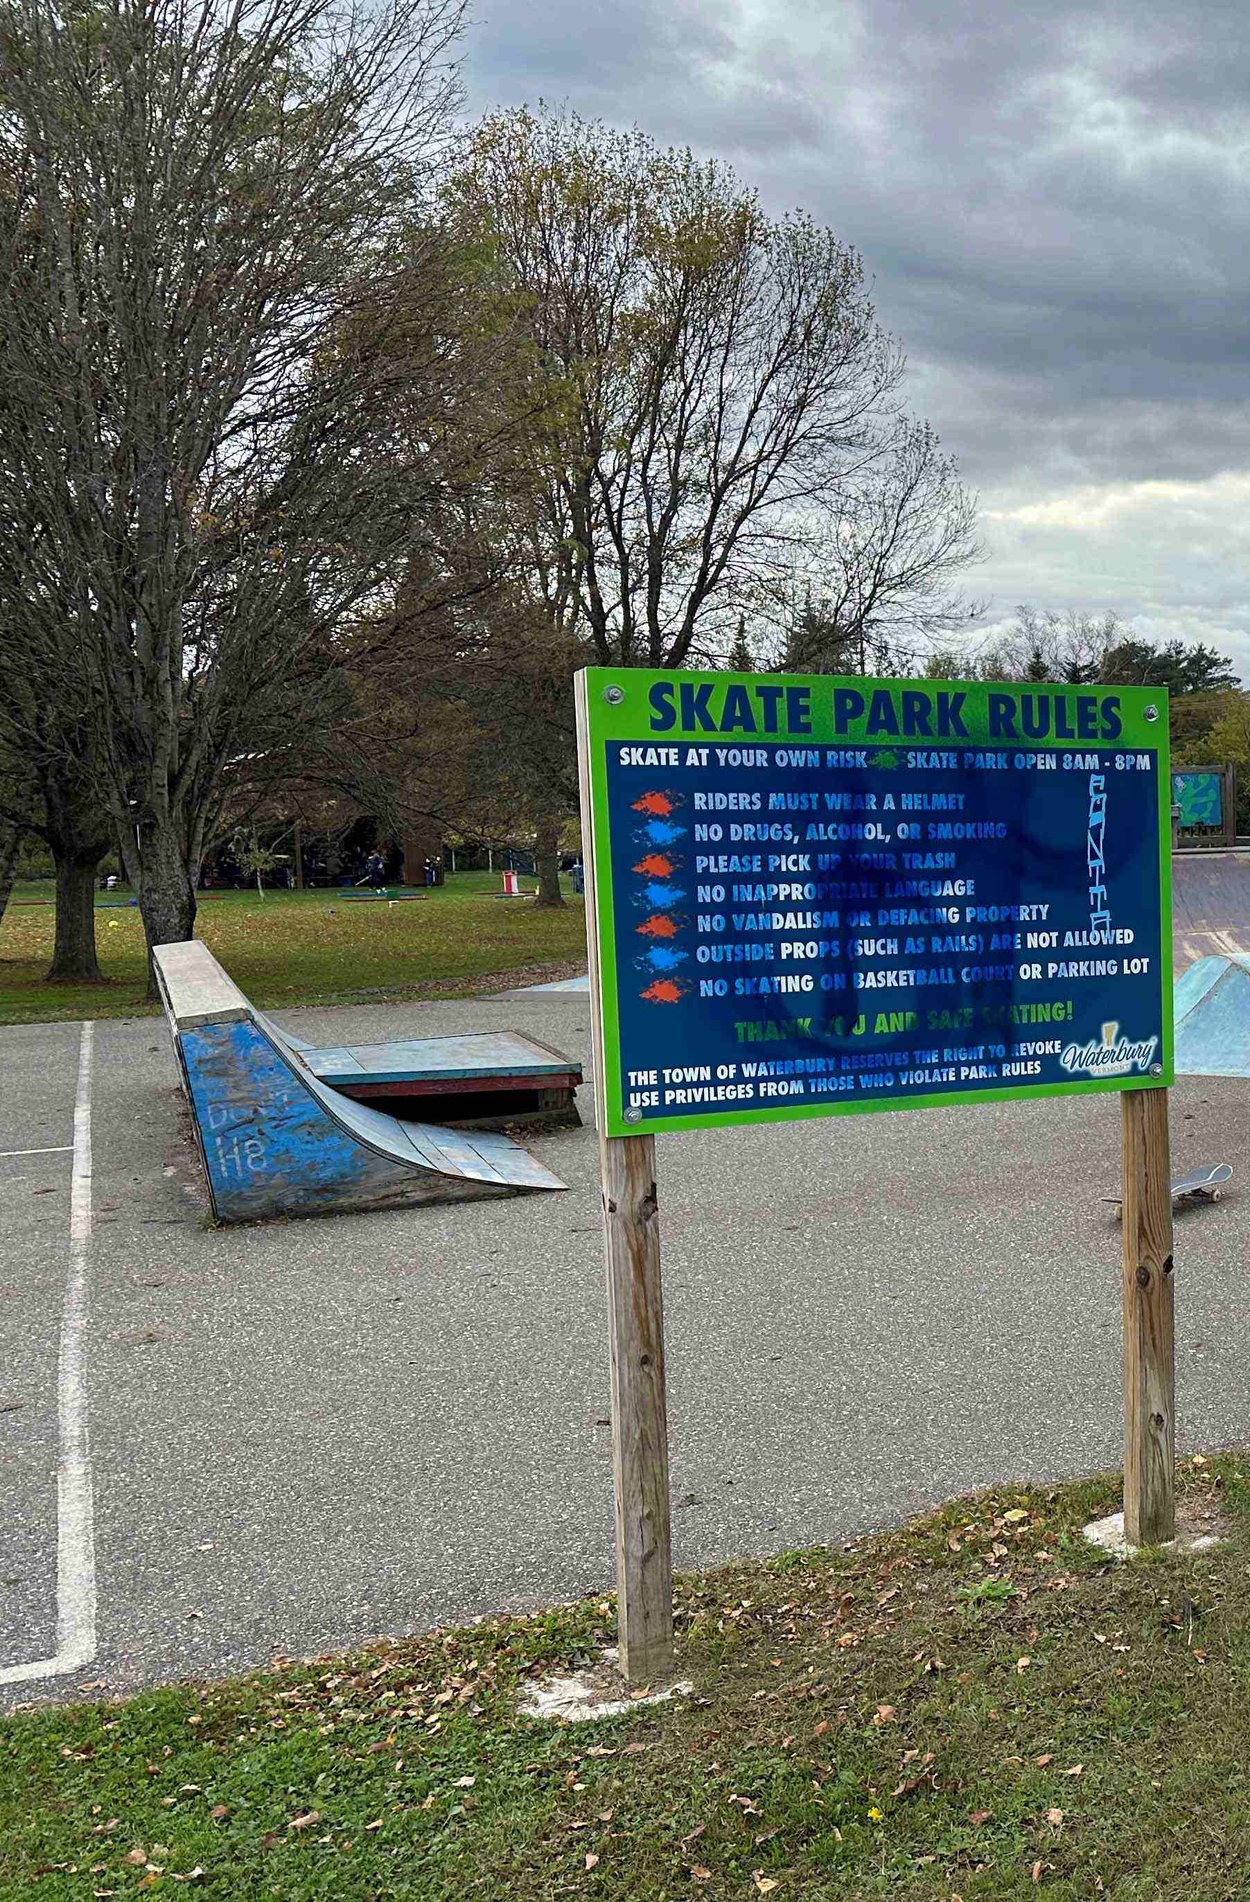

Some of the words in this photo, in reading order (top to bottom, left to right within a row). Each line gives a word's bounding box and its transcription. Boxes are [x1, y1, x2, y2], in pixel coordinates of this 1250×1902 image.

[649, 681, 812, 734] SKATE
[834, 687, 970, 738] PARK
[988, 692, 1123, 741] RULES
[620, 747, 679, 766] SKATE
[685, 748, 710, 766] AT
[715, 749, 768, 767] YOUR
[775, 750, 820, 767] OWN
[827, 751, 868, 768] RISK
[907, 751, 957, 769] SKATE
[964, 752, 1008, 769] PARK
[1014, 753, 1057, 770] OPEN
[1062, 753, 1100, 770] 8AM
[1114, 754, 1151, 771] 8PM
[694, 792, 762, 811] RIDERS
[768, 792, 818, 811] MUST
[825, 793, 876, 811] WEAR
[883, 793, 896, 811] A
[901, 793, 965, 810] HELMET
[695, 823, 723, 841] NO
[730, 823, 800, 844] DRUGS,
[806, 823, 891, 843] ALCOHOL,
[897, 822, 921, 840] OR
[928, 822, 1007, 840] SMOKING
[696, 854, 762, 873] PLEASE
[769, 854, 811, 872] PICK
[817, 854, 842, 871] UP
[903, 851, 956, 870] TRASH
[697, 885, 725, 903] NO
[732, 882, 880, 902] INAPPROPRIATE
[885, 879, 975, 898] LANGUAGE
[697, 914, 725, 932] NO
[732, 911, 840, 931] VANDALISM
[849, 910, 872, 928] OR
[878, 906, 960, 926] DEFACING
[966, 904, 1050, 924] PROPERTY
[696, 943, 774, 963] OUTSIDE
[780, 940, 840, 960] PROPS
[848, 937, 899, 960] (SUCH
[904, 936, 928, 954] AS
[931, 934, 984, 955] RAILS)
[990, 932, 1021, 950] ARE
[1026, 931, 1059, 949] NOT
[1063, 928, 1135, 948] ALLOWED
[700, 979, 728, 998] NO
[734, 974, 814, 996] SKATING
[820, 972, 847, 991] ON
[854, 966, 956, 990] BASKETBALL
[961, 964, 1014, 984] COURT
[1019, 963, 1043, 980] OR
[1047, 959, 1118, 979] PARKING
[1123, 957, 1150, 975] LOT
[734, 1017, 813, 1044] THANK
[822, 1014, 866, 1038] OU
[873, 1010, 919, 1035] AND
[927, 1006, 973, 1028] SAFE
[628, 1069, 658, 1087] THE
[663, 1065, 711, 1084] TOWN
[716, 1064, 737, 1080] OF
[742, 1056, 835, 1078] WATERBURY
[841, 1050, 910, 1071] RESERVES
[914, 1048, 939, 1065] THE
[943, 1045, 984, 1063] RIGHT
[989, 1043, 1006, 1059] TO
[1011, 1039, 1062, 1057] REVOKE
[1062, 1038, 1153, 1071] Waterbury
[1091, 1063, 1130, 1074] VERMONT
[629, 1091, 660, 1108] USE
[664, 1083, 754, 1105] PRIVILEGES
[759, 1079, 805, 1097] FROM
[809, 1075, 855, 1092] THOSE
[859, 1071, 894, 1089] WHO
[899, 1067, 956, 1086] VIOLATE
[960, 1063, 997, 1081] PARK
[1002, 1060, 1042, 1076] RULES
